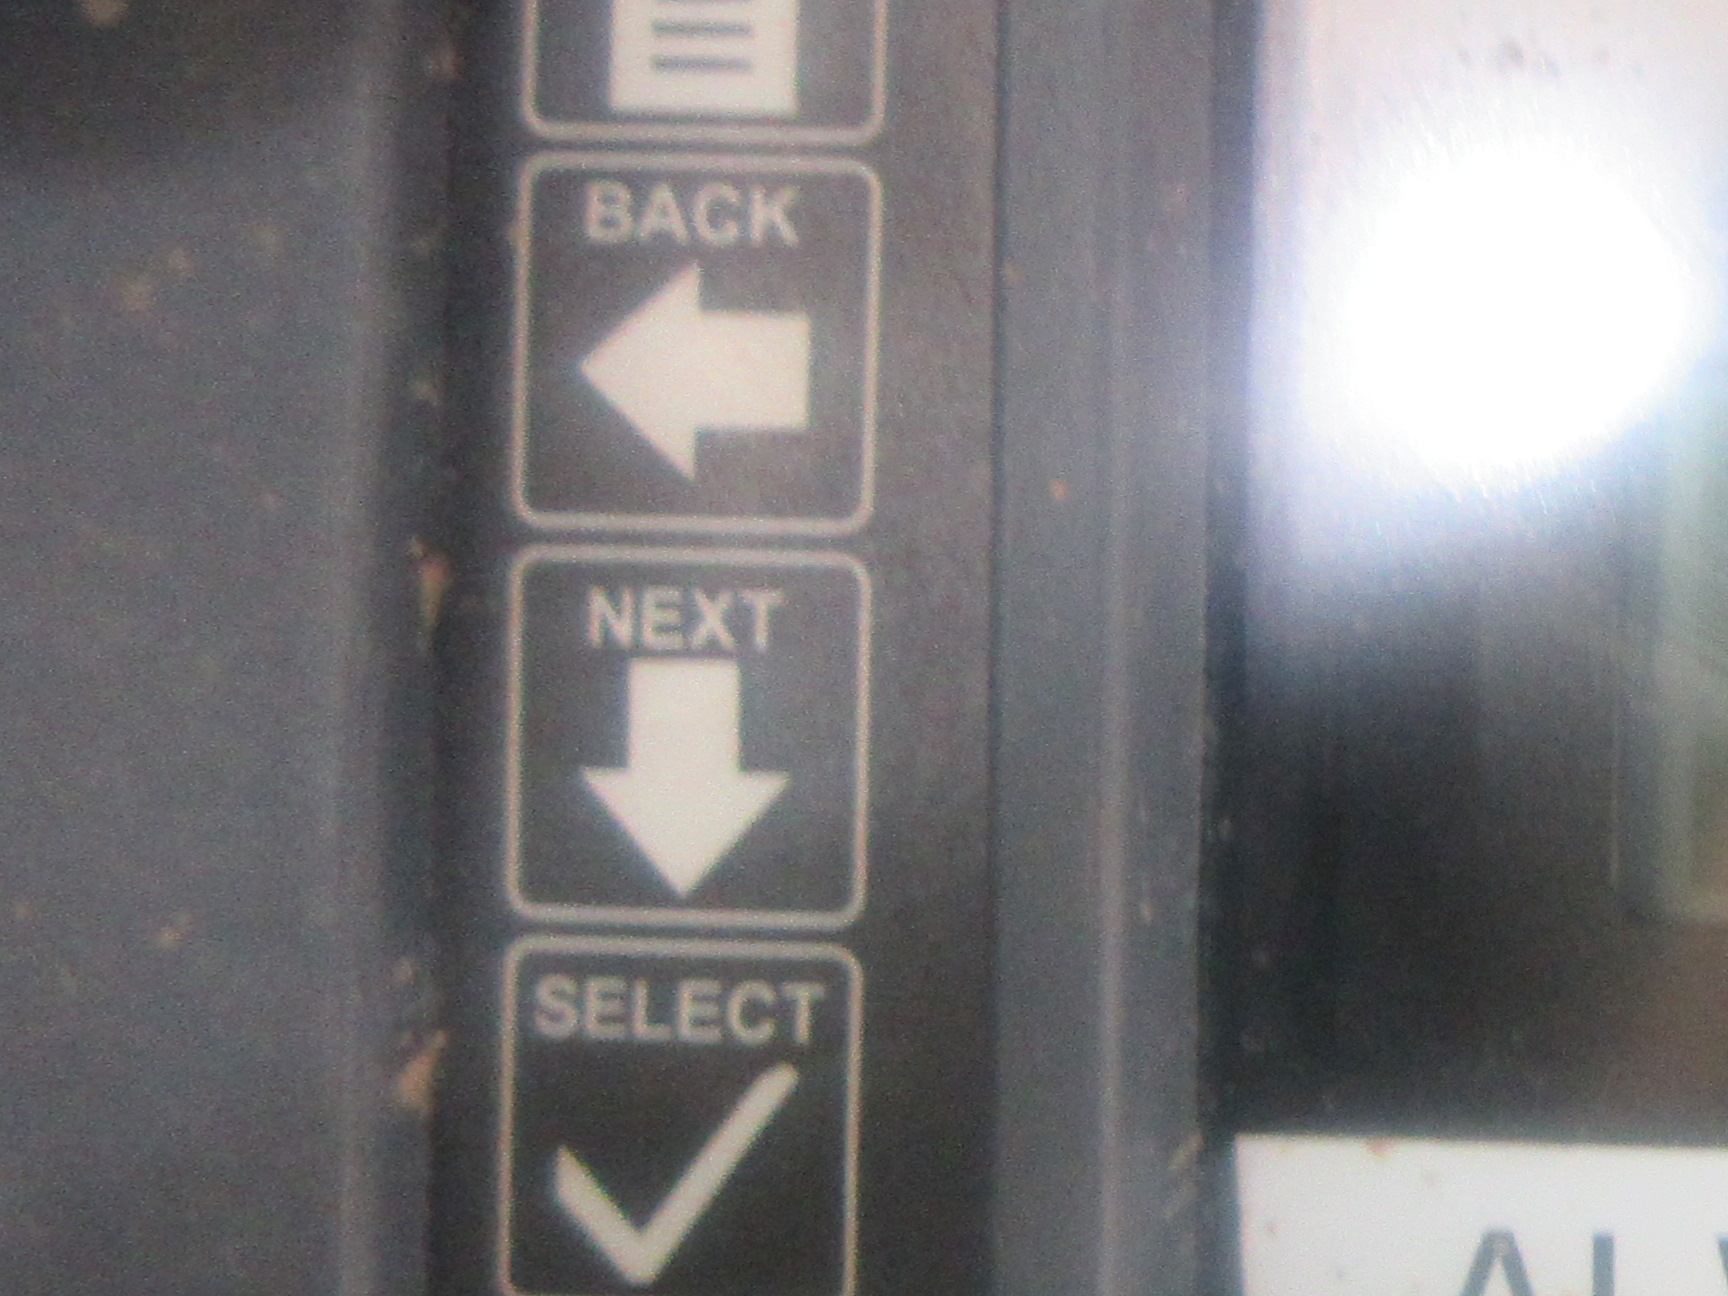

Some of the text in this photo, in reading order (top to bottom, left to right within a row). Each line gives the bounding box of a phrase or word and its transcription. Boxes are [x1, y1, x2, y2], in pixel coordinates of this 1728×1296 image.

[583, 182, 799, 247] BACK
[587, 589, 784, 651] NEXT
[533, 977, 825, 1044] SELECT
